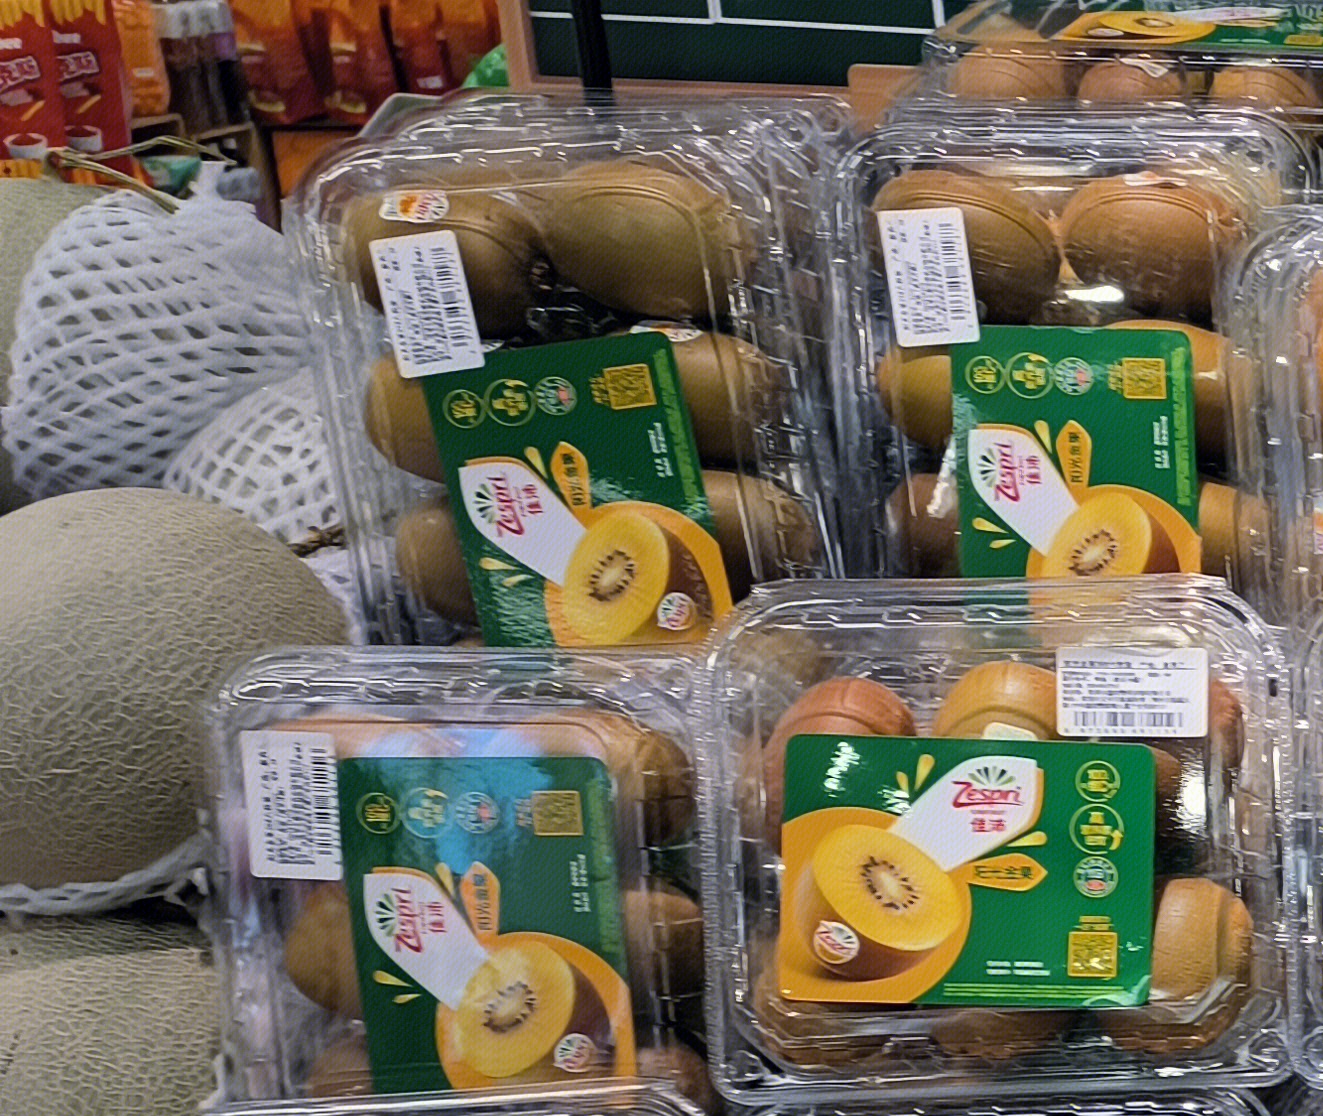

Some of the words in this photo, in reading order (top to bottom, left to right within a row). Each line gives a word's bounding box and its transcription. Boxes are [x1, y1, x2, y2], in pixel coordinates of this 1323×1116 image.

[994, 441, 1021, 503] Zespri
[494, 472, 525, 537] Zespri
[951, 780, 1025, 809] Zespri
[970, 817, 1007, 833] 佳沛
[394, 886, 424, 954] Zespri
